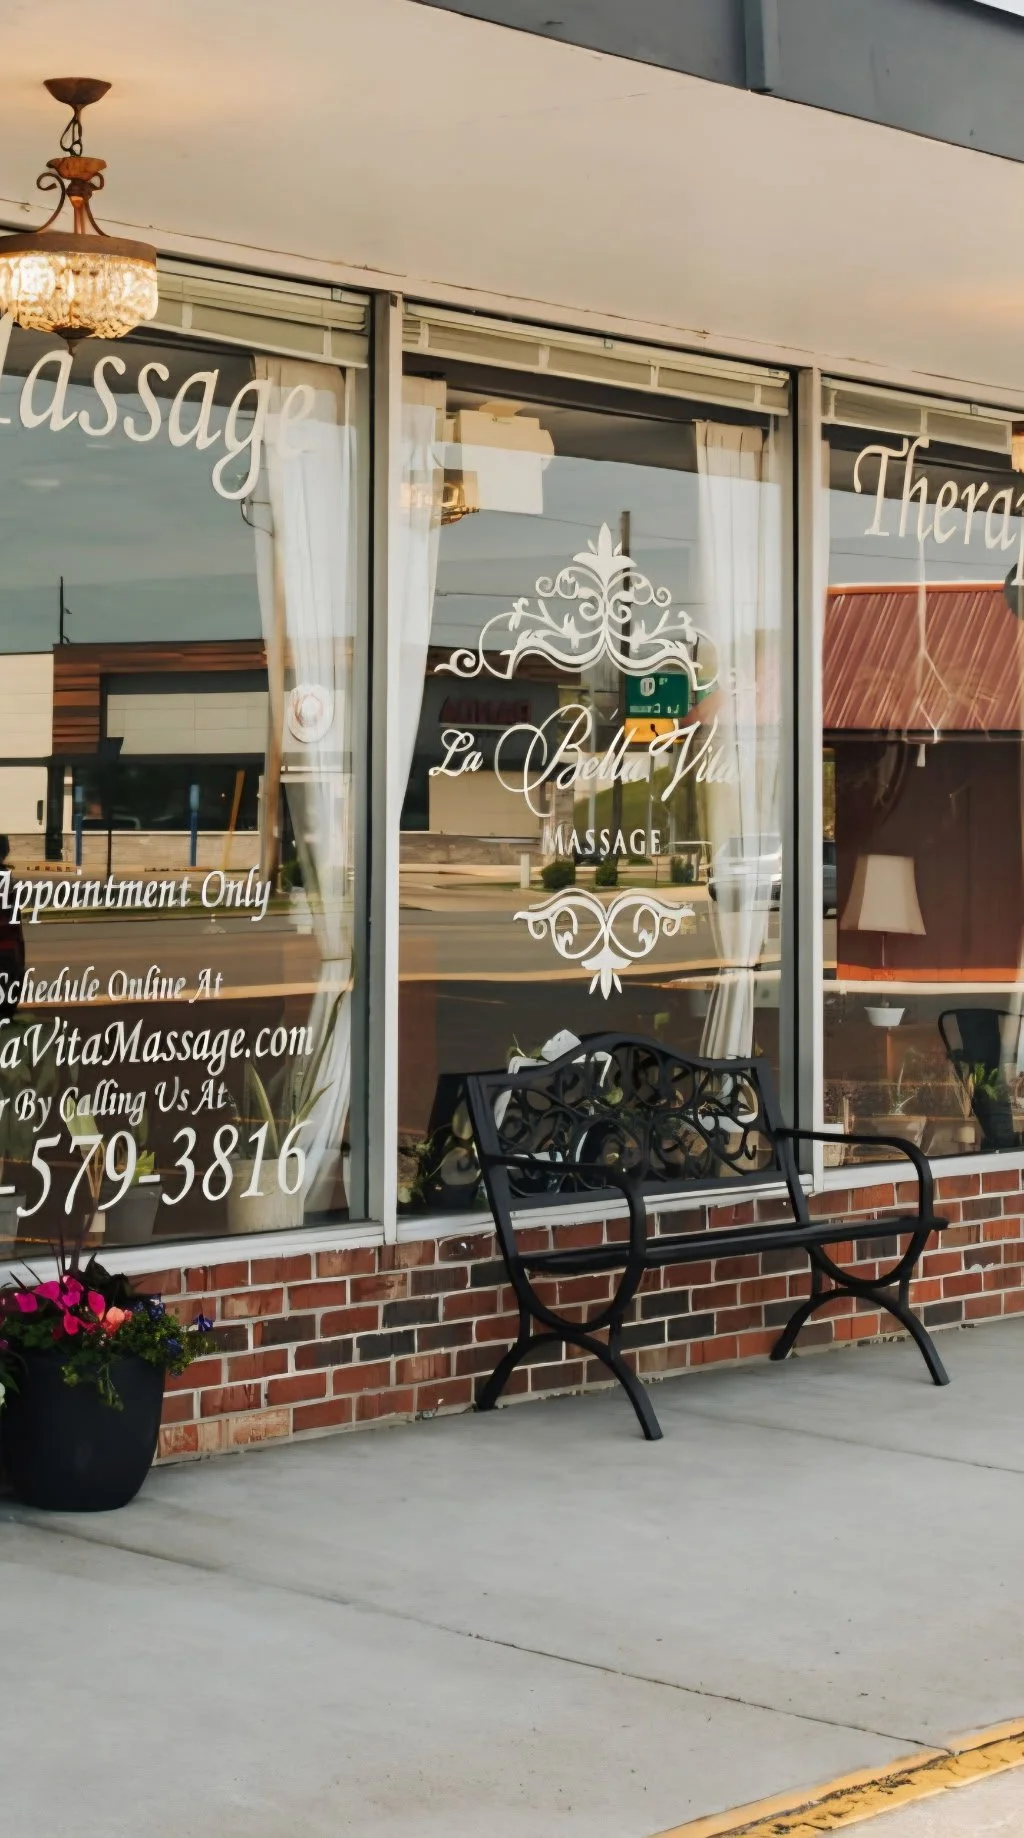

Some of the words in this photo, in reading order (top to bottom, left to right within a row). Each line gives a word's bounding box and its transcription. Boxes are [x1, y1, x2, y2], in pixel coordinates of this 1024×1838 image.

[429, 729, 483, 777] La
[494, 704, 649, 817] Bella
[545, 828, 662, 856] MASSAGE
[201, 864, 272, 922] Only
[108, 965, 185, 1000] Online
[188, 968, 223, 1003] At
[16, 1090, 51, 1132] By
[60, 1079, 146, 1125] Calling
[155, 1077, 189, 1111] Us
[193, 1079, 227, 1115] At
